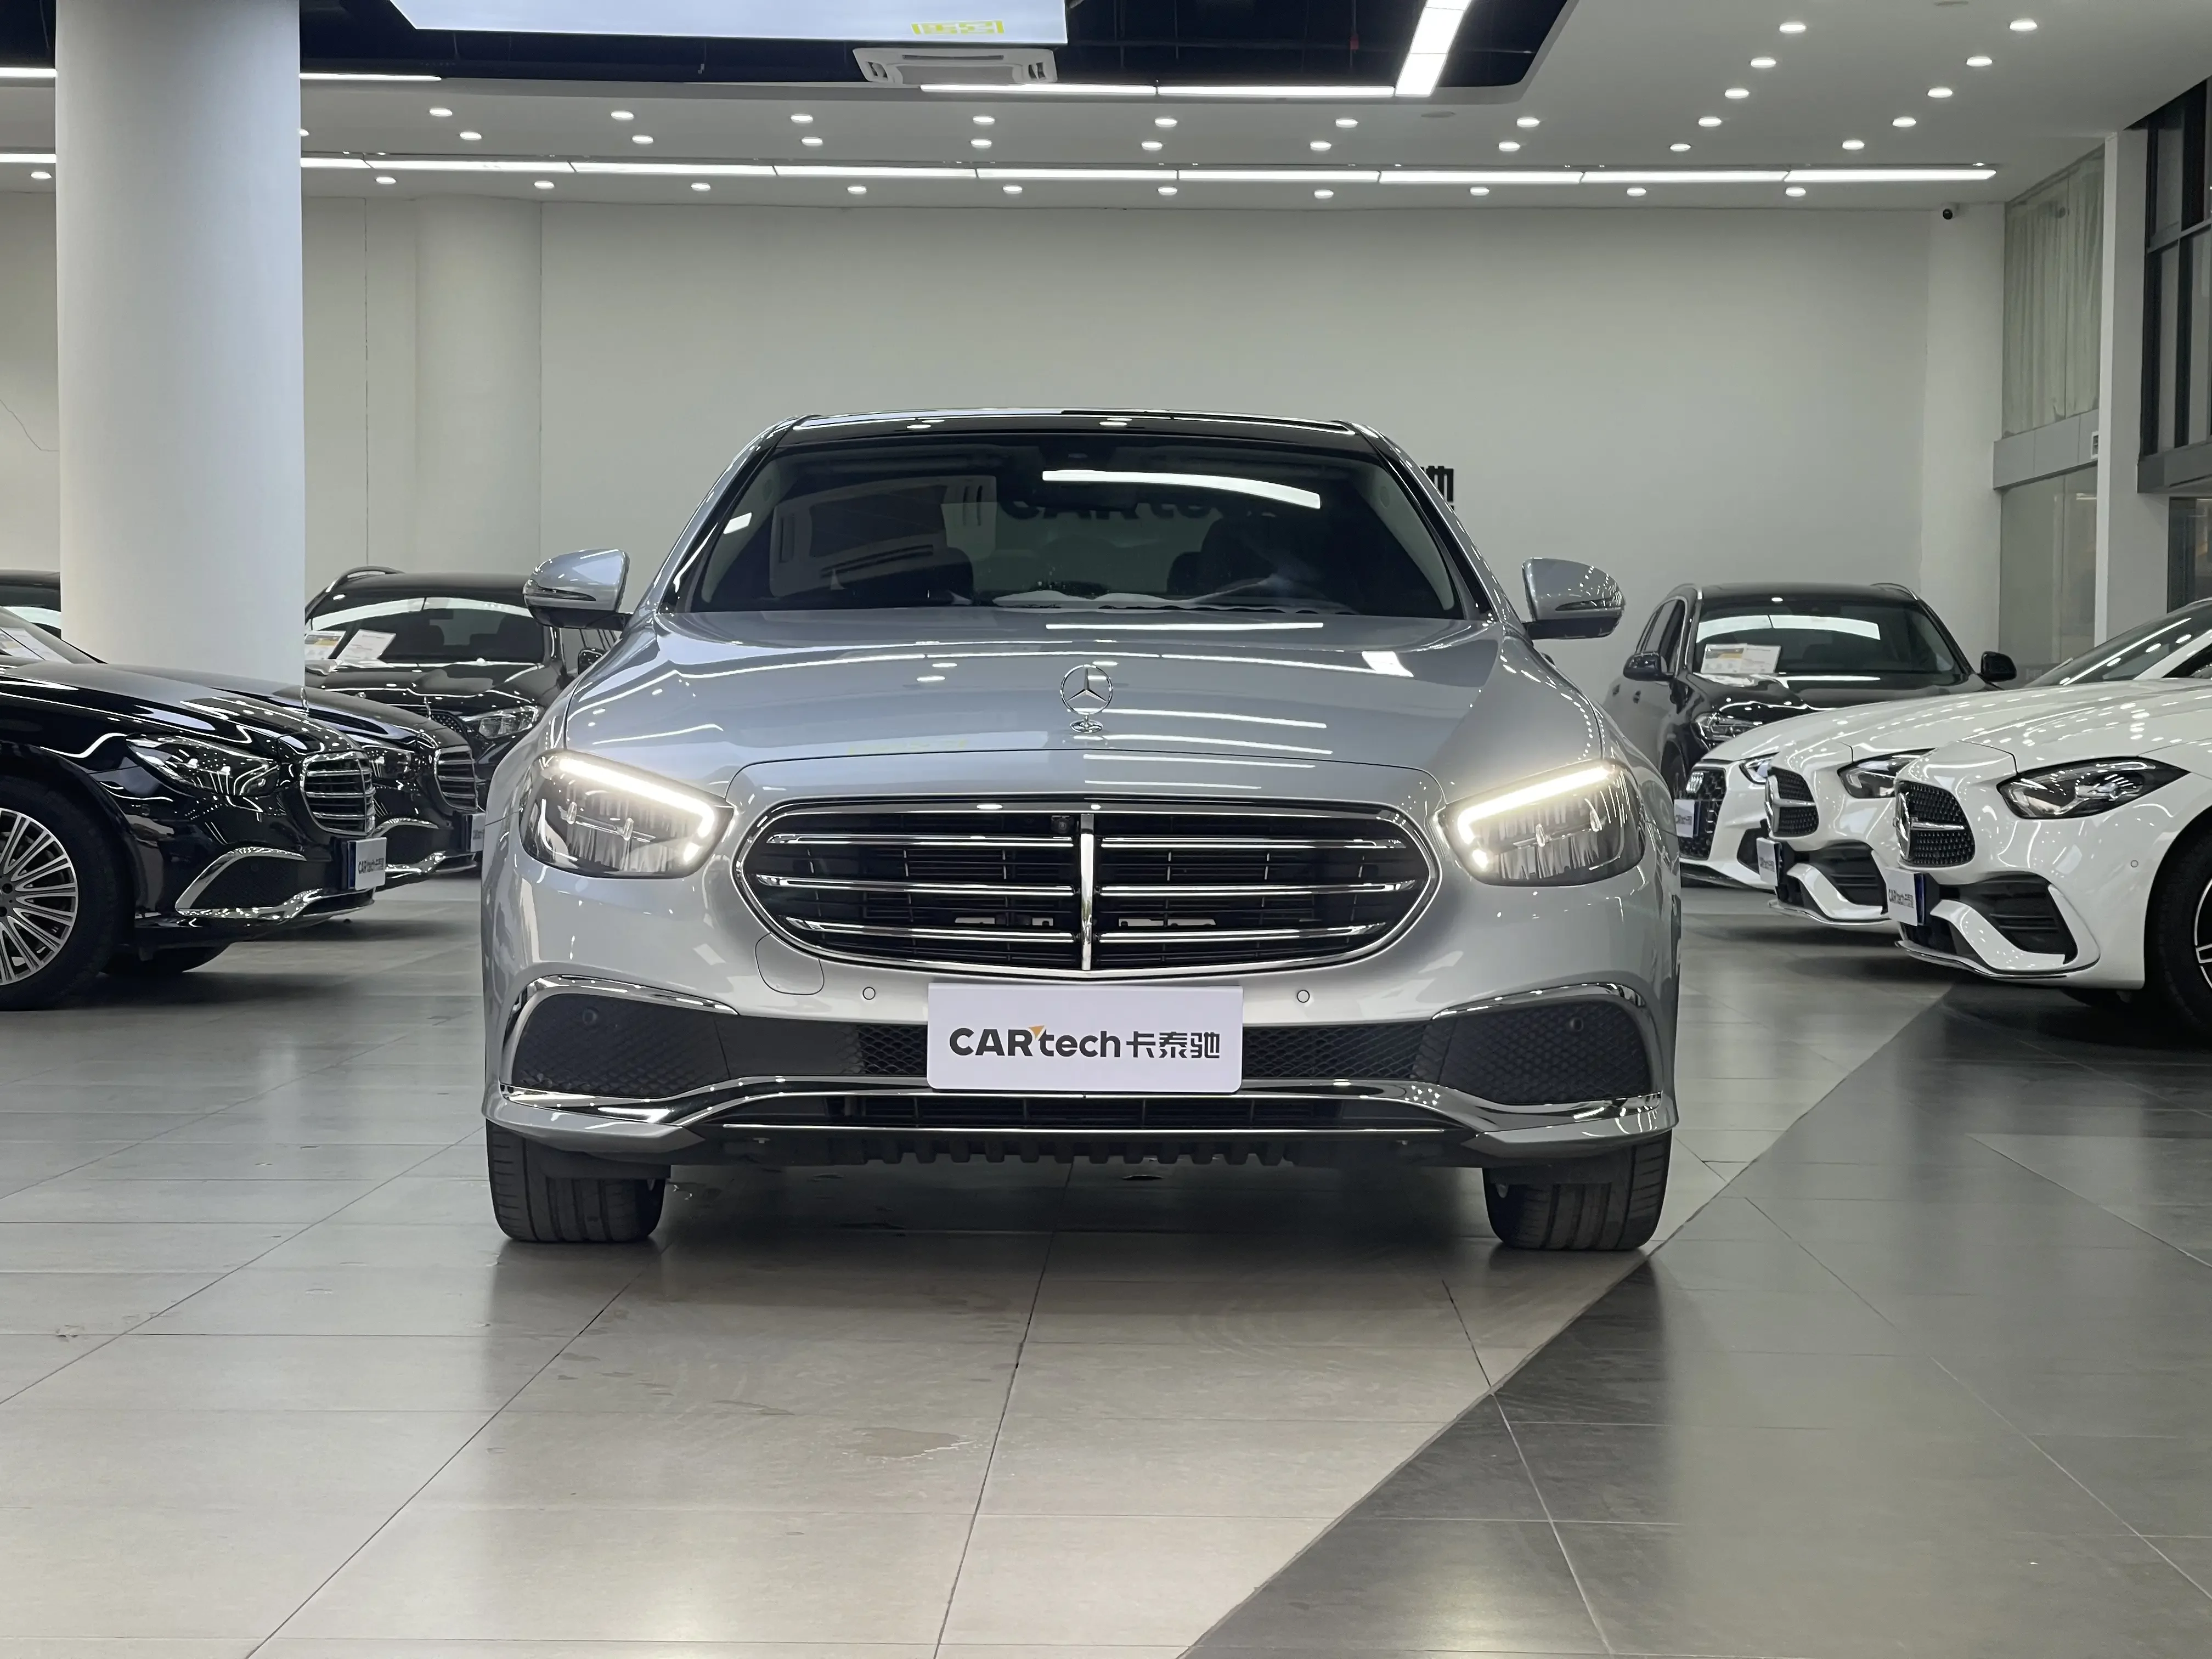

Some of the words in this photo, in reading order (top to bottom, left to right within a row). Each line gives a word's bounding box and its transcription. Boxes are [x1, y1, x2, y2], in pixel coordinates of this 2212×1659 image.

[949, 1025, 1121, 1058] CARtech
[1126, 1031, 1220, 1059] 卡泰驰
